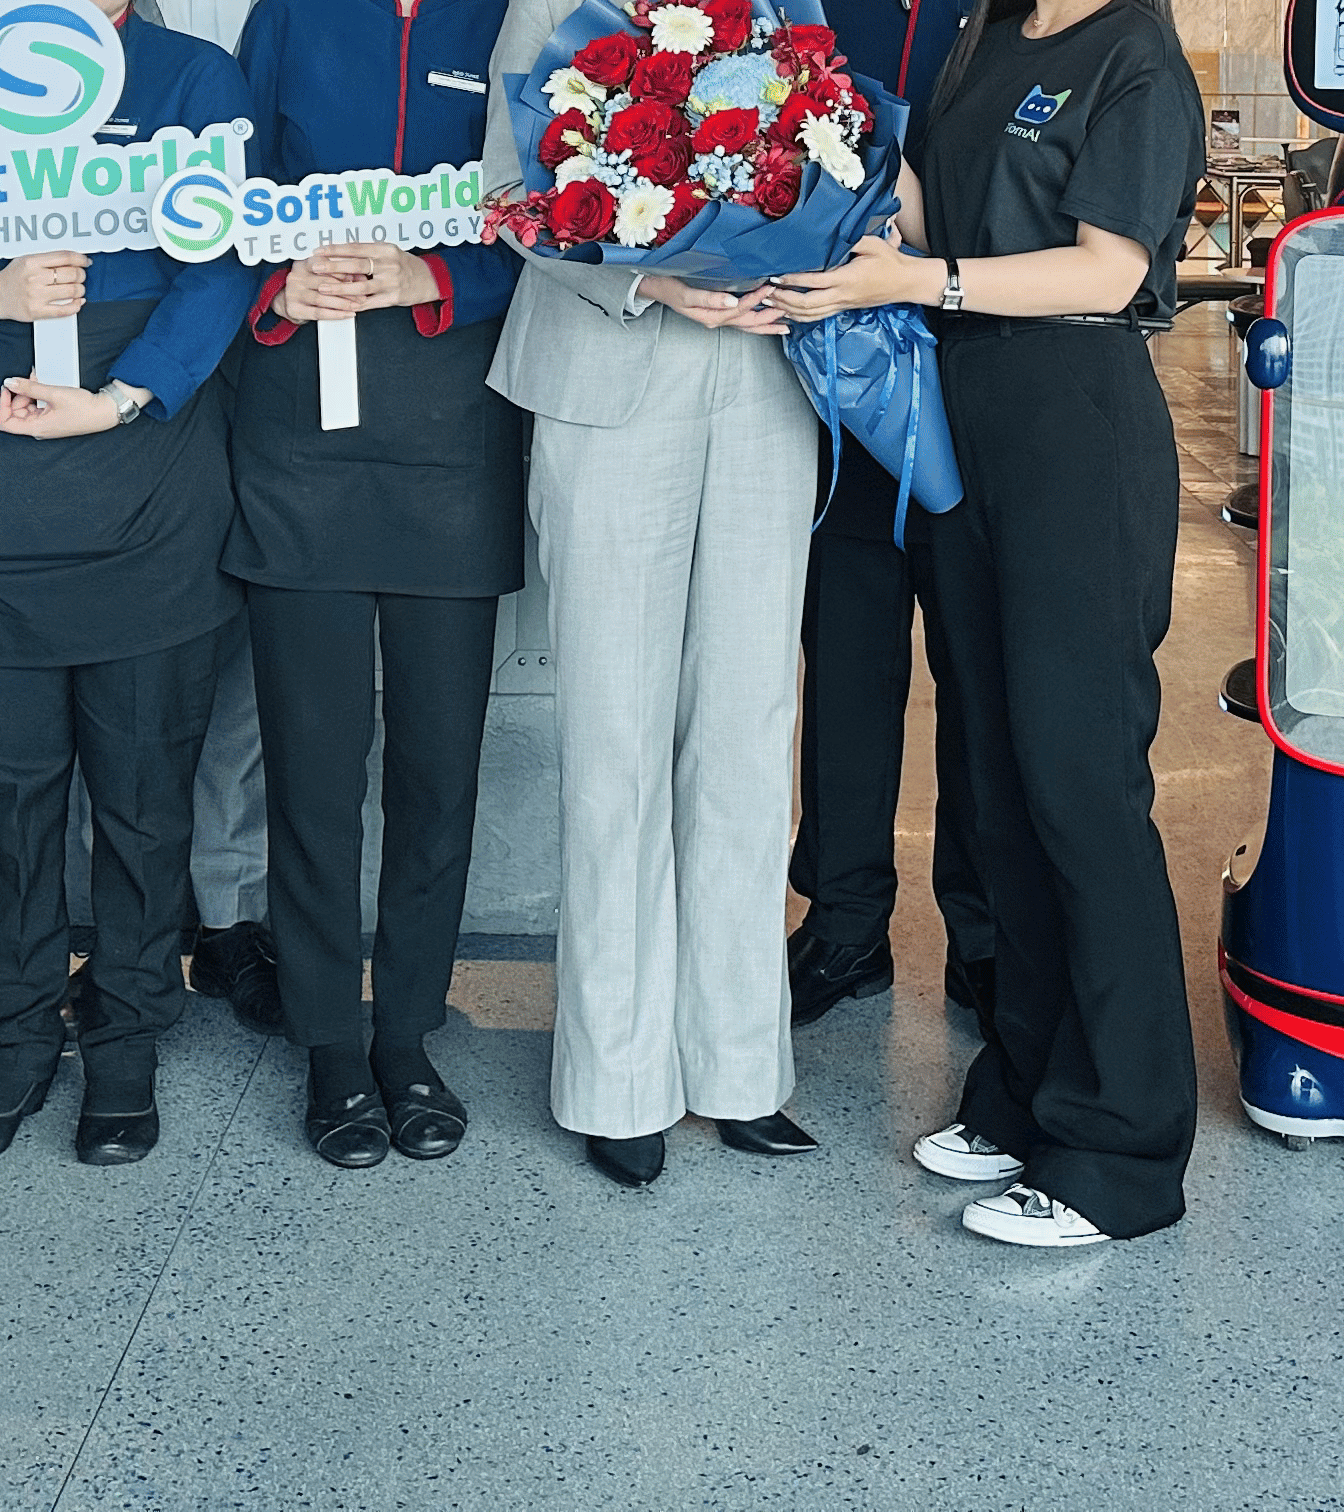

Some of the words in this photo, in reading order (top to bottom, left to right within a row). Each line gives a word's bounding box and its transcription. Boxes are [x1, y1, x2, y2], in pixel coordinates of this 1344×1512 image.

[1003, 122, 1041, 143] TomAI
[242, 170, 480, 227] SoftWorld
[244, 215, 482, 257] TECHNOLOGY
